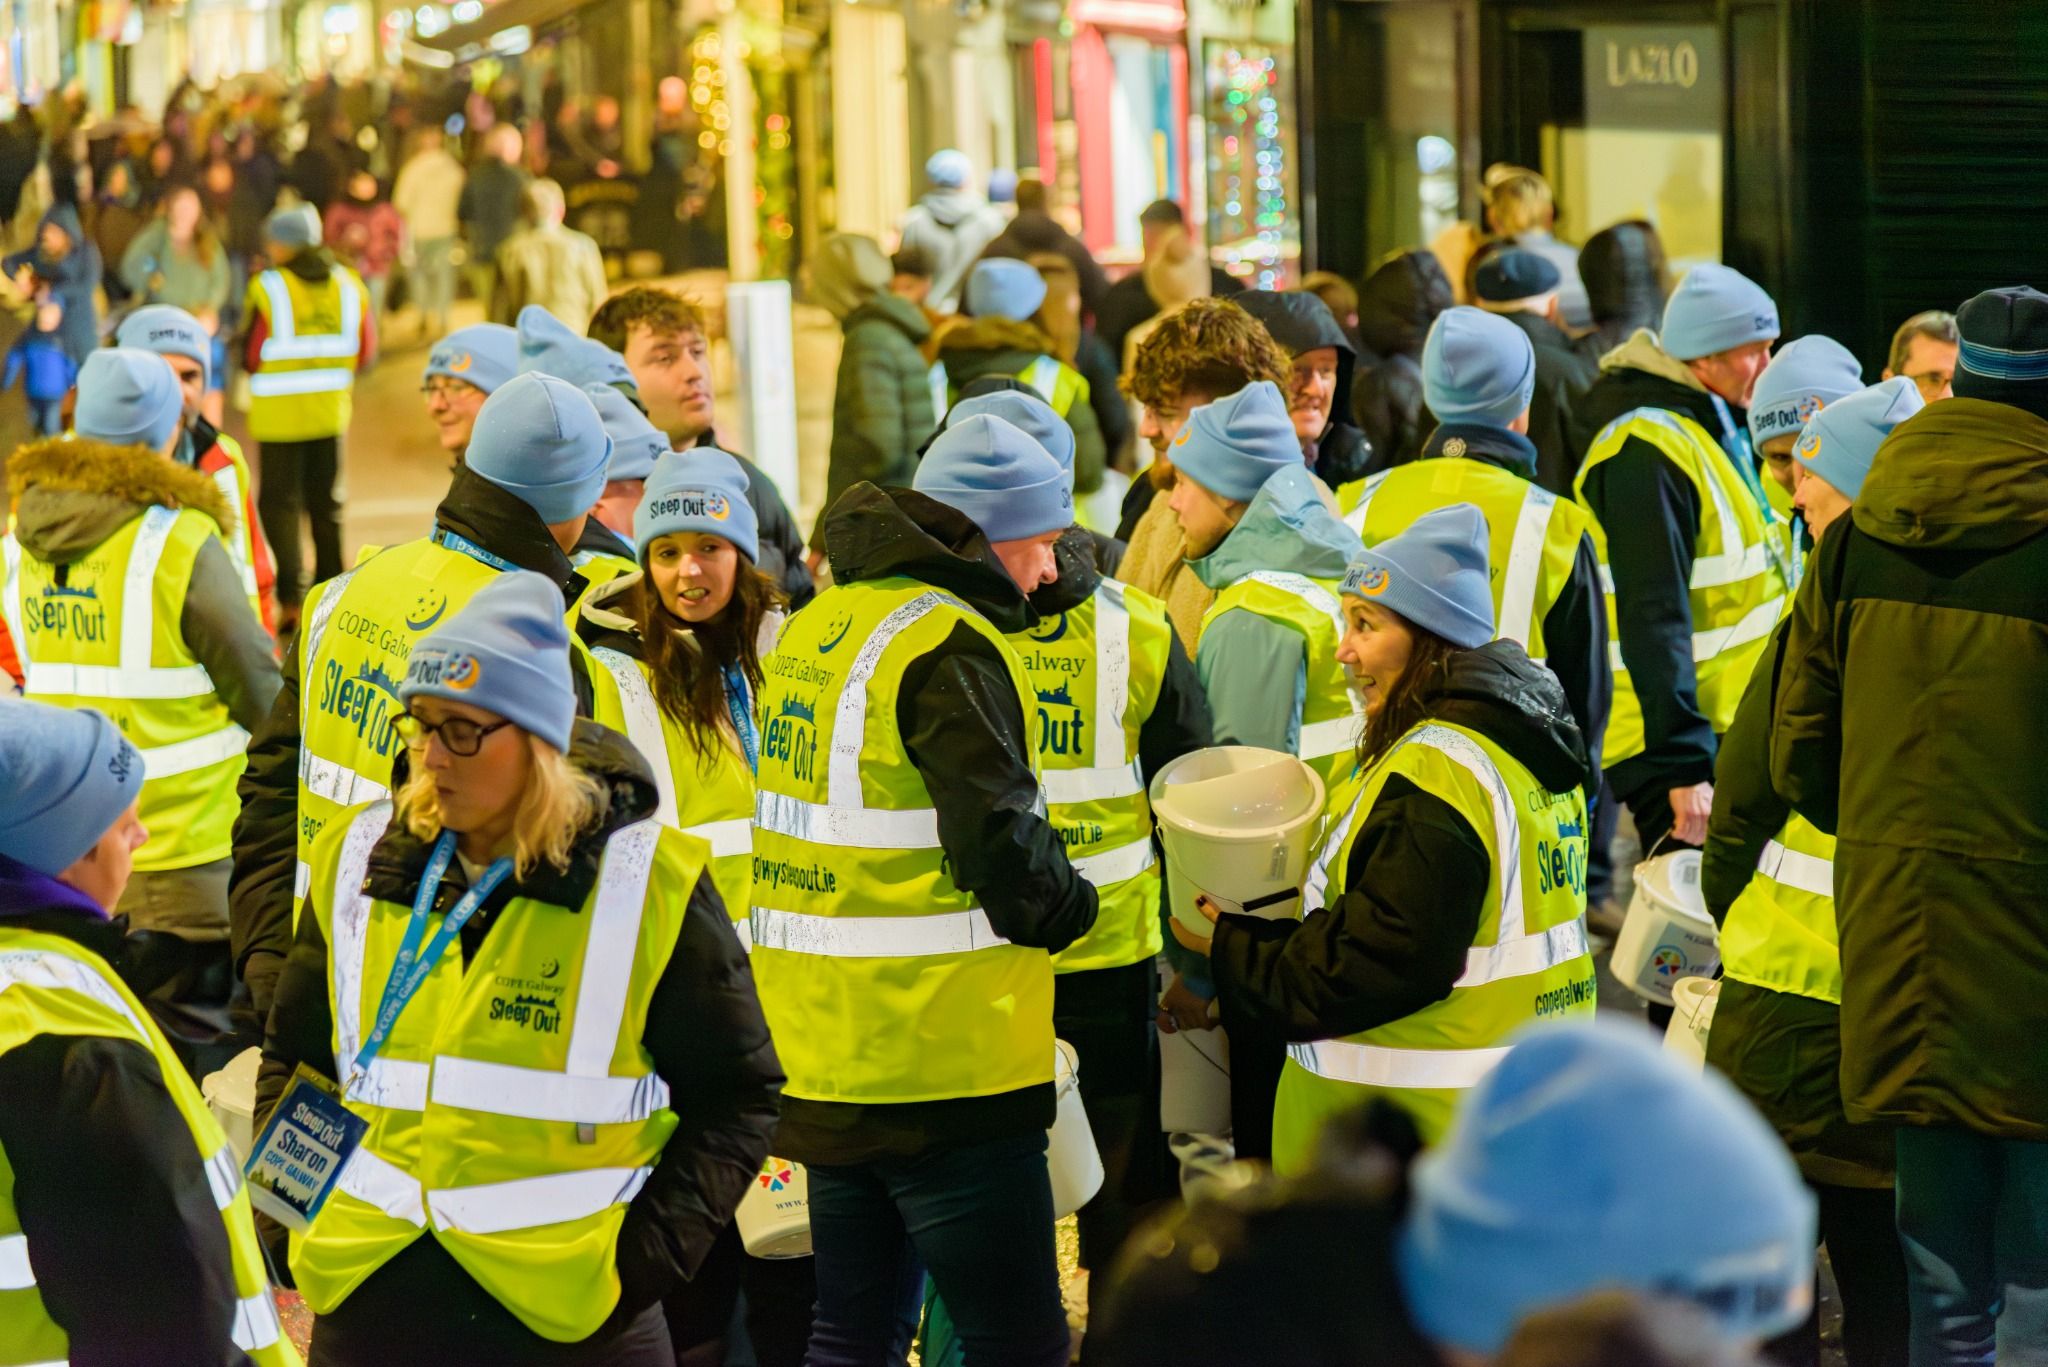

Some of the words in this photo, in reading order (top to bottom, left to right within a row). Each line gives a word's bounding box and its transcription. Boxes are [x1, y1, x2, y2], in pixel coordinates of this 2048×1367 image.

[1778, 405, 1800, 428] Out
[650, 498, 680, 519] Sleep
[683, 498, 706, 516] Out
[73, 604, 106, 643] Out
[337, 610, 379, 645] COPE
[379, 629, 413, 661] Galw
[796, 660, 835, 693] Galway
[1023, 650, 1086, 678] alway
[761, 706, 802, 773] leep
[1038, 708, 1084, 755] Out
[495, 976, 522, 989] COPE
[526, 980, 565, 996] Galway
[489, 996, 531, 1029] Sleep
[533, 1008, 561, 1034] Out
[292, 1102, 325, 1136] Sleep
[319, 1126, 345, 1151] Out
[264, 1150, 285, 1171] COPE
[285, 1163, 320, 1192] GALWAY
[277, 1129, 328, 1174] Sharon
